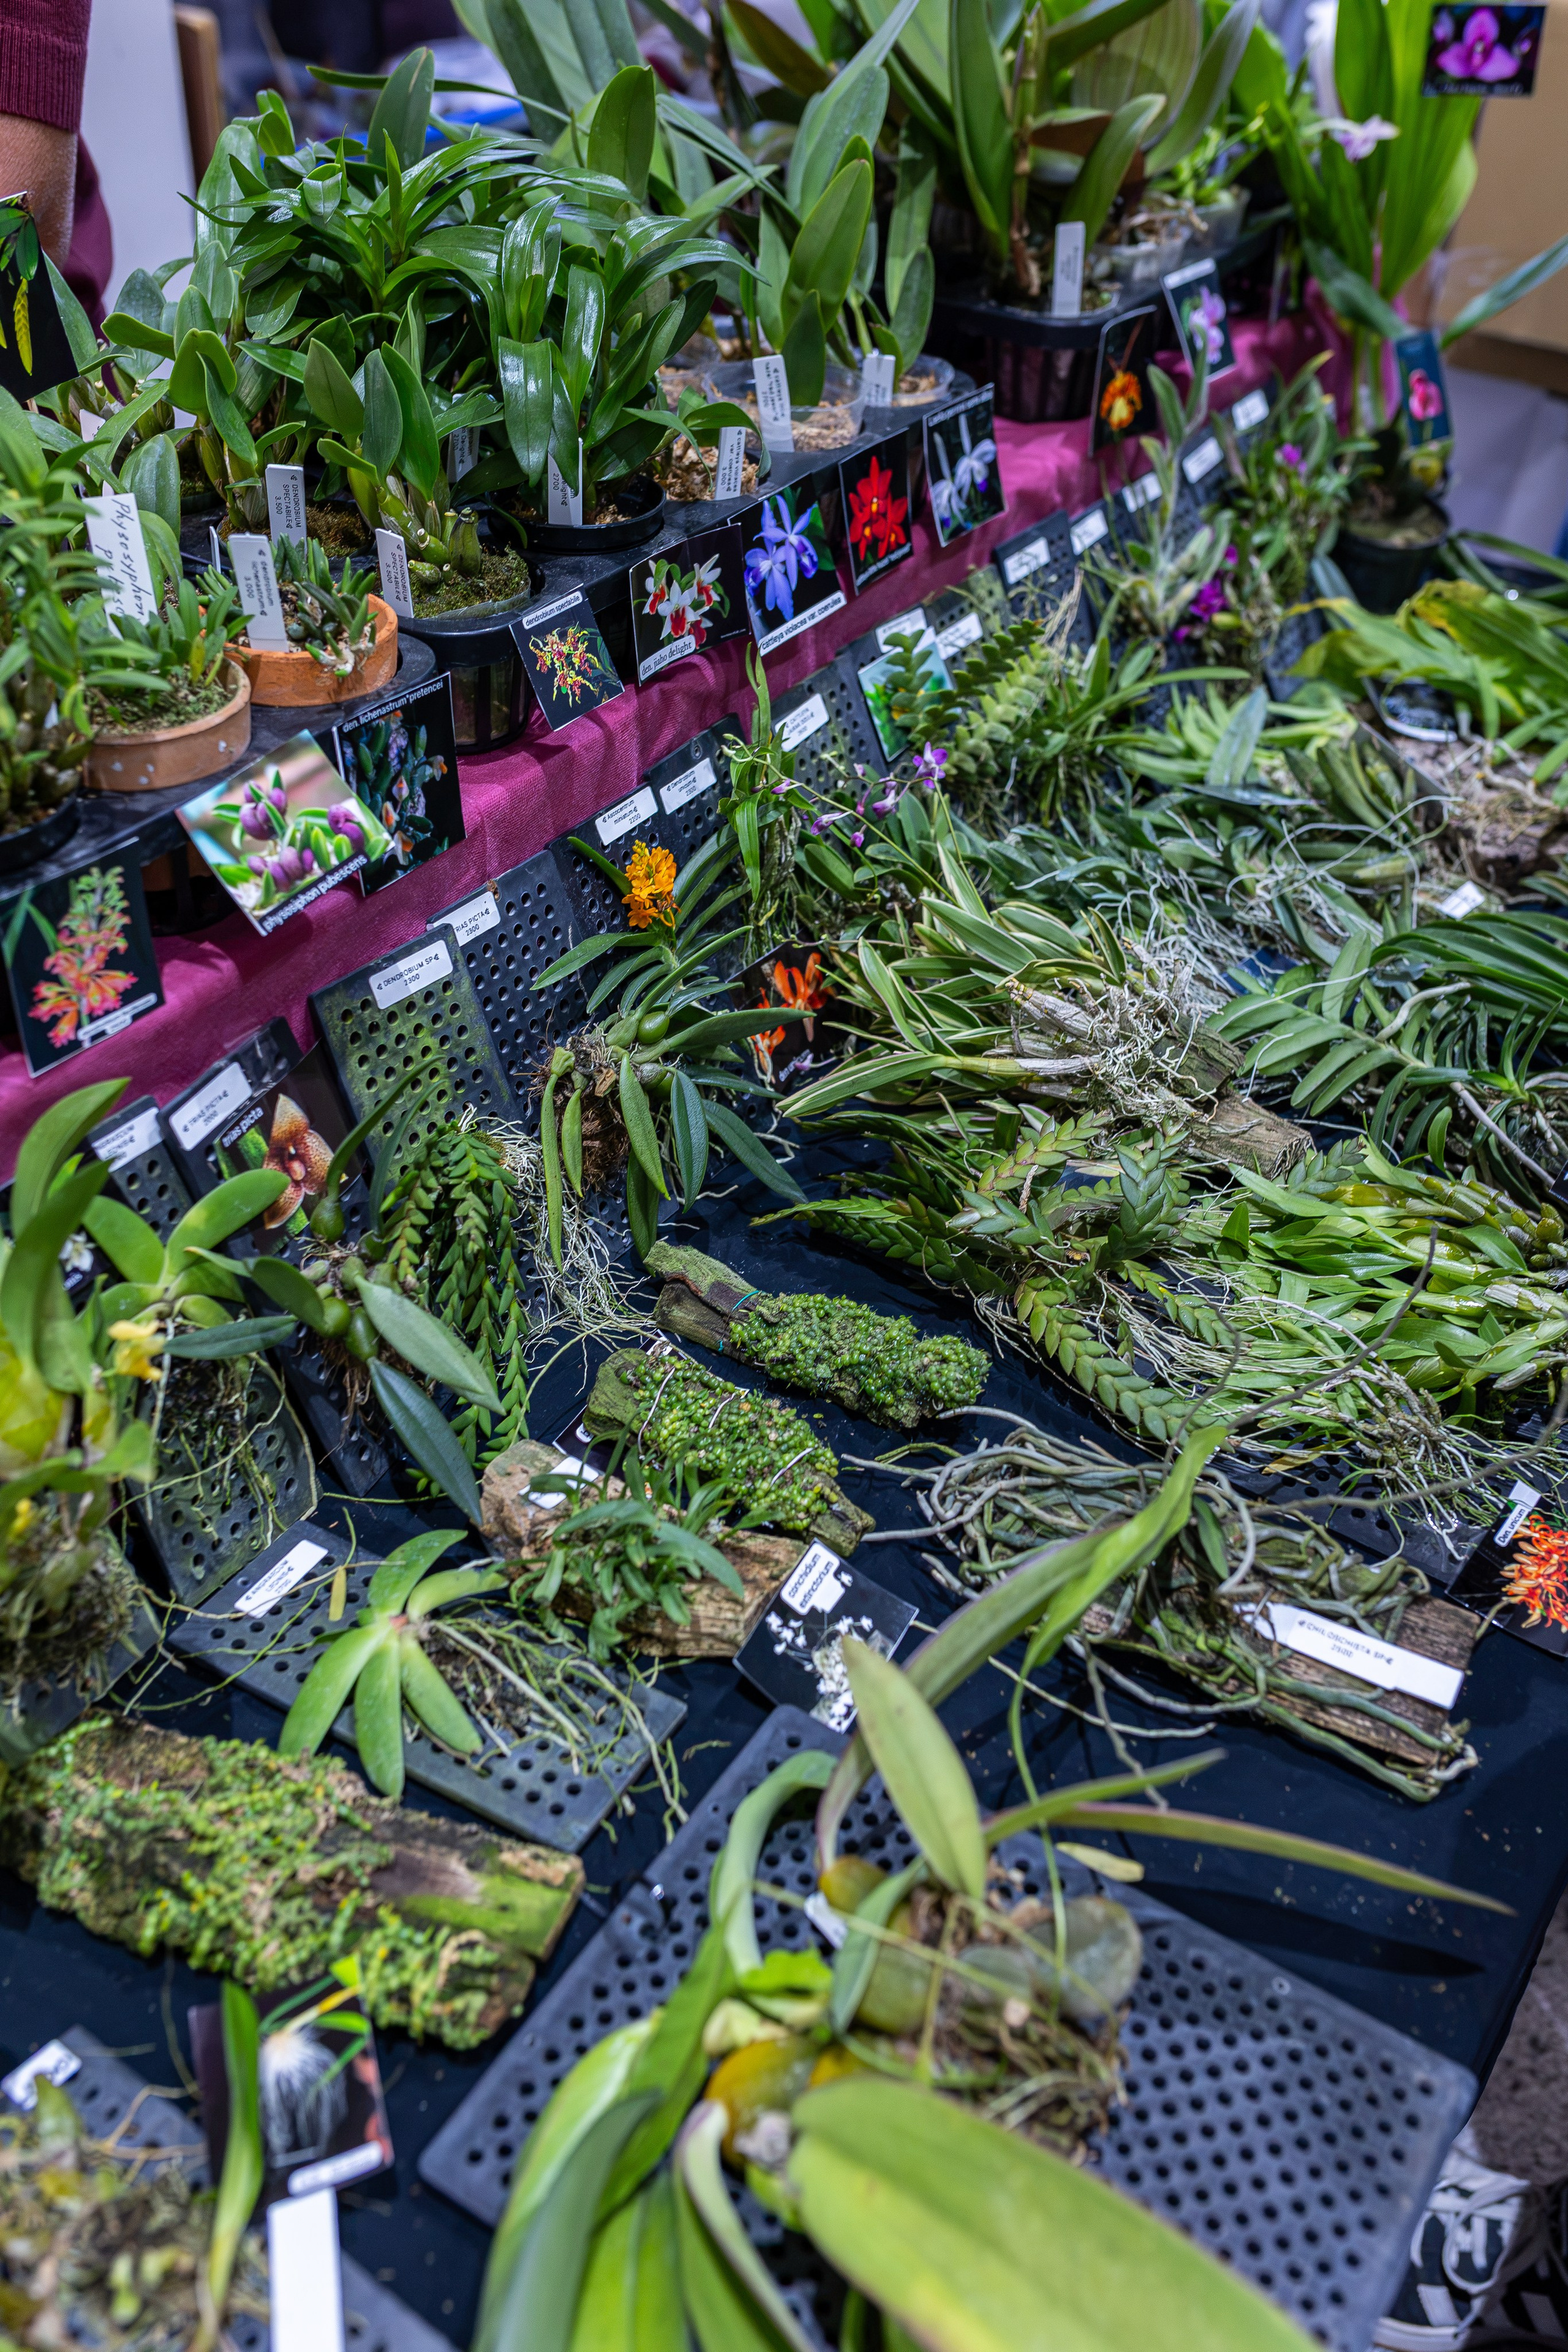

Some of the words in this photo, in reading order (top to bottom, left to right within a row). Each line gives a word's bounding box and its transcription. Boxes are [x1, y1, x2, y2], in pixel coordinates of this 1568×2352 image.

[274, 496, 283, 515] 3.500
[282, 483, 293, 523] SPECTABILE
[292, 484, 301, 528] DENDROBIUM
[391, 551, 401, 596] SPECTABILE
[398, 554, 408, 602] DENDROBIUM
[526, 608, 556, 626] dendrobium
[556, 595, 580, 612] spectabile
[784, 617, 808, 635] violacea
[653, 654, 668, 671] jiaho
[668, 641, 692, 658] delight
[607, 799, 635, 820] Ascocentrum
[614, 809, 634, 825] miniatum
[262, 887, 322, 933] physosiphon
[317, 854, 368, 895] pubescens
[465, 923, 480, 937] 2300
[468, 911, 485, 925] PICTA
[383, 960, 424, 987] DENDROBIUM
[424, 956, 434, 965] SP
[404, 973, 420, 986] 2300
[221, 1126, 243, 1148] trias
[239, 1106, 264, 1133] picta
[1509, 1509, 1526, 1530] unicum
[788, 1553, 821, 1598] conchidium
[799, 1560, 834, 1608] extinctorium
